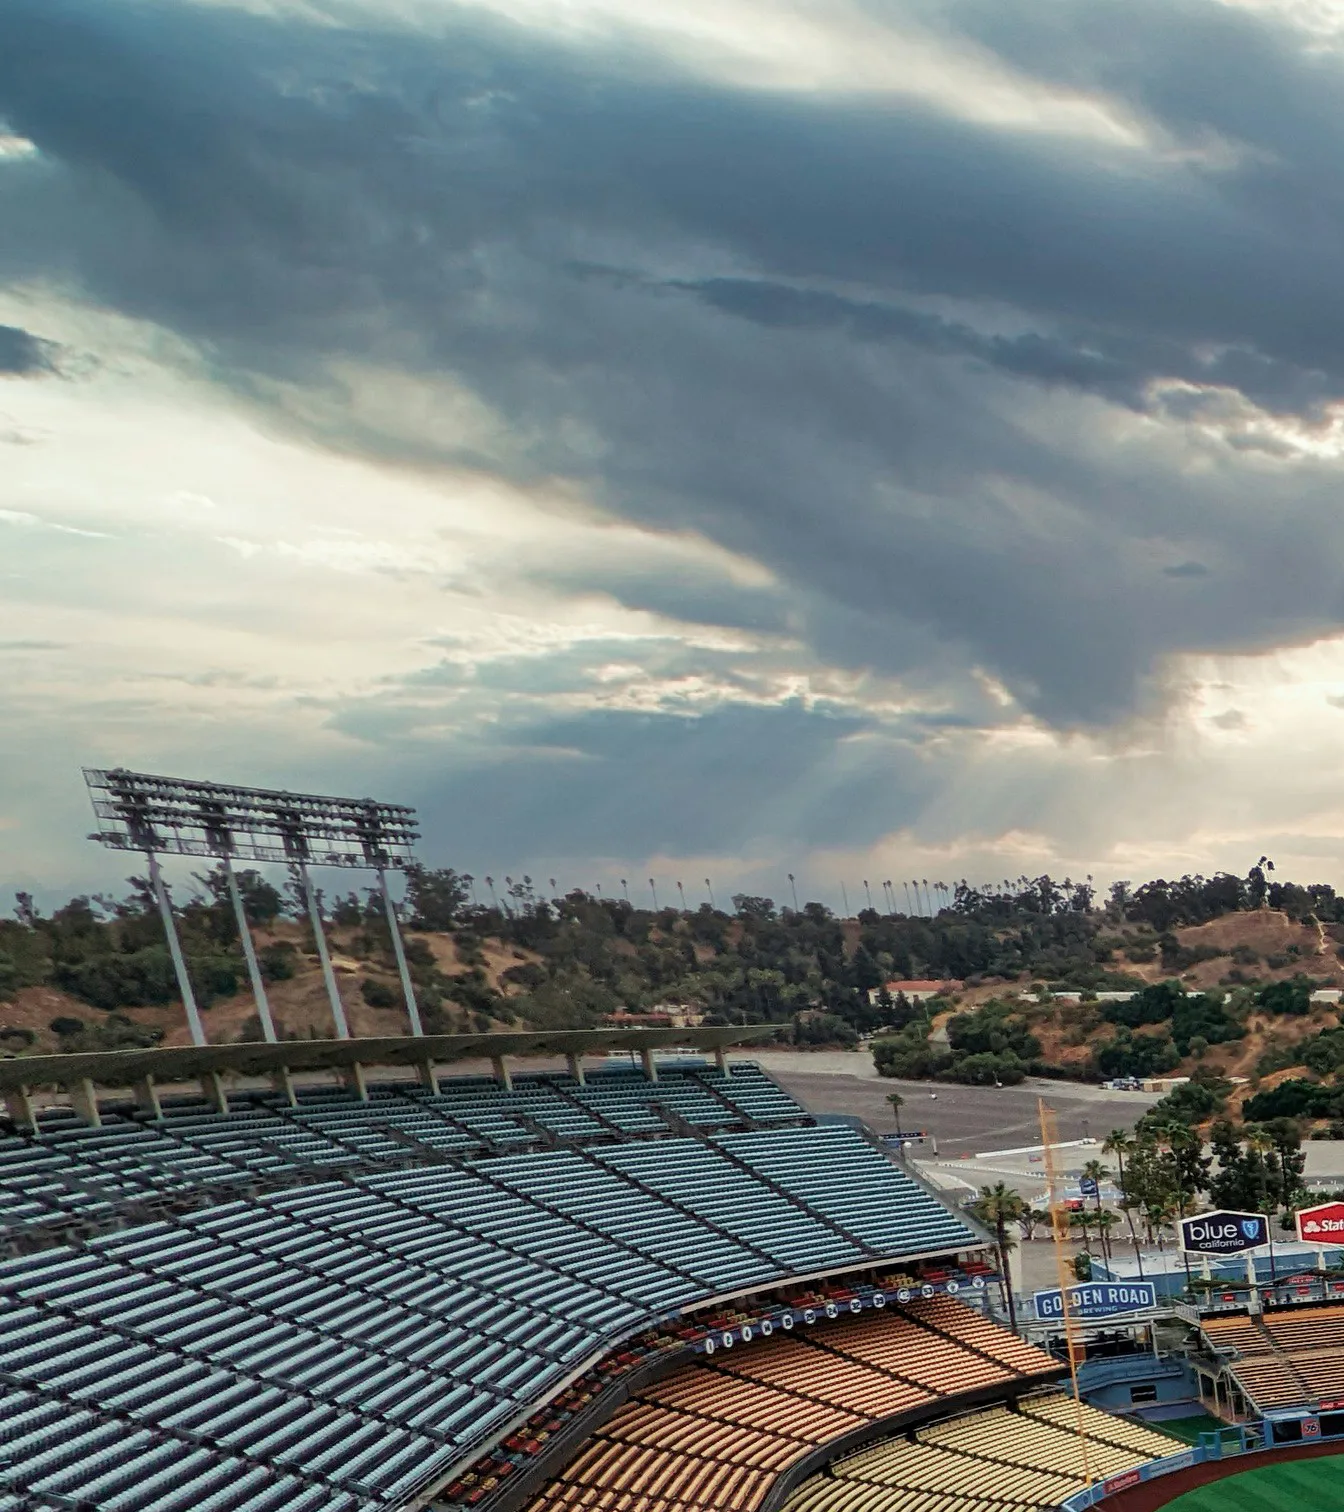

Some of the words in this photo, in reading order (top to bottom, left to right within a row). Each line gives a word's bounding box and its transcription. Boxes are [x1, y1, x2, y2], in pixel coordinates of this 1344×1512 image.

[1190, 1222, 1238, 1241] blue
[1199, 1239, 1245, 1249] california
[1108, 1288, 1149, 1305] ROAD
